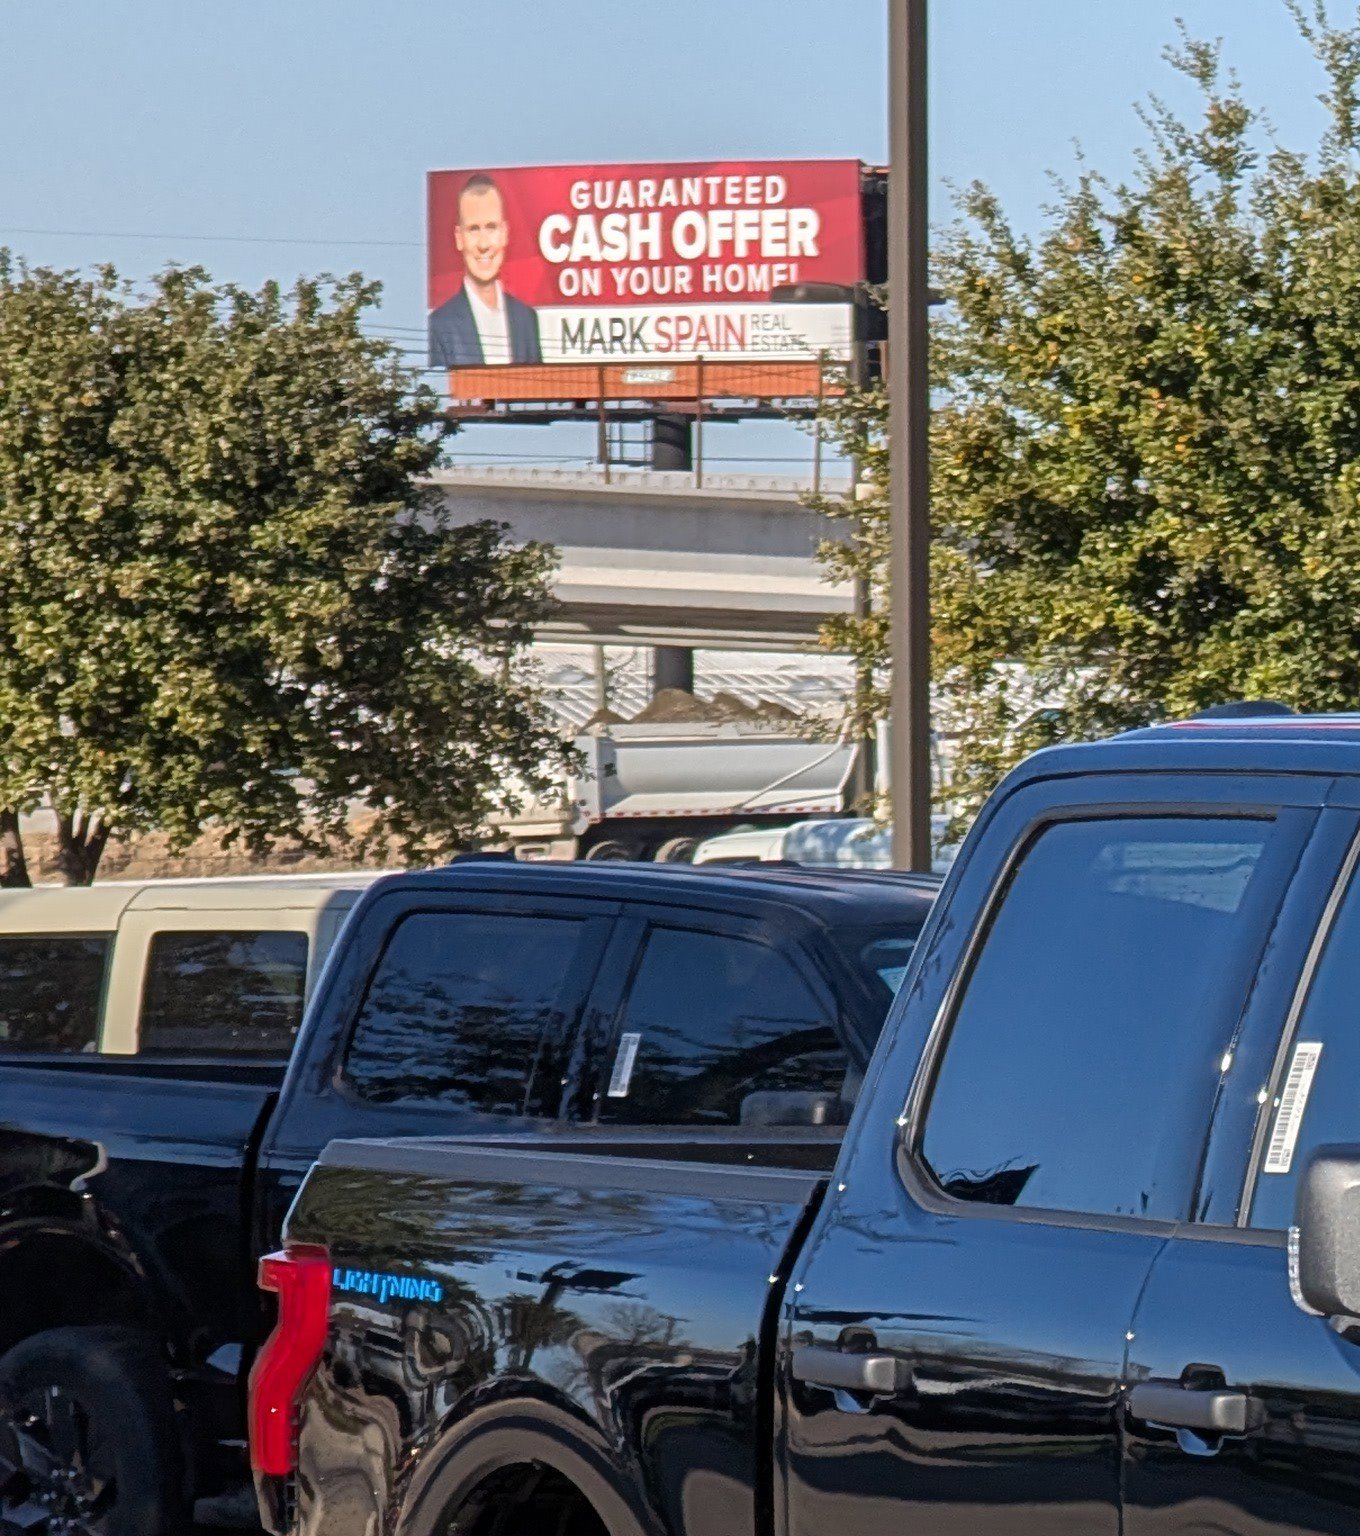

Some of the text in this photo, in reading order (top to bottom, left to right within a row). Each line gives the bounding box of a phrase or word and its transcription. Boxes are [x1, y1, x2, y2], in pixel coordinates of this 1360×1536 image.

[570, 175, 787, 210] GUARANTEED
[539, 208, 820, 263] CASH OFFER
[558, 268, 601, 297] ON
[611, 266, 693, 296] YOUR
[560, 314, 748, 355] MARK SPAIN
[751, 313, 791, 331] REAL
[333, 1267, 445, 1304] LIGHTNING
